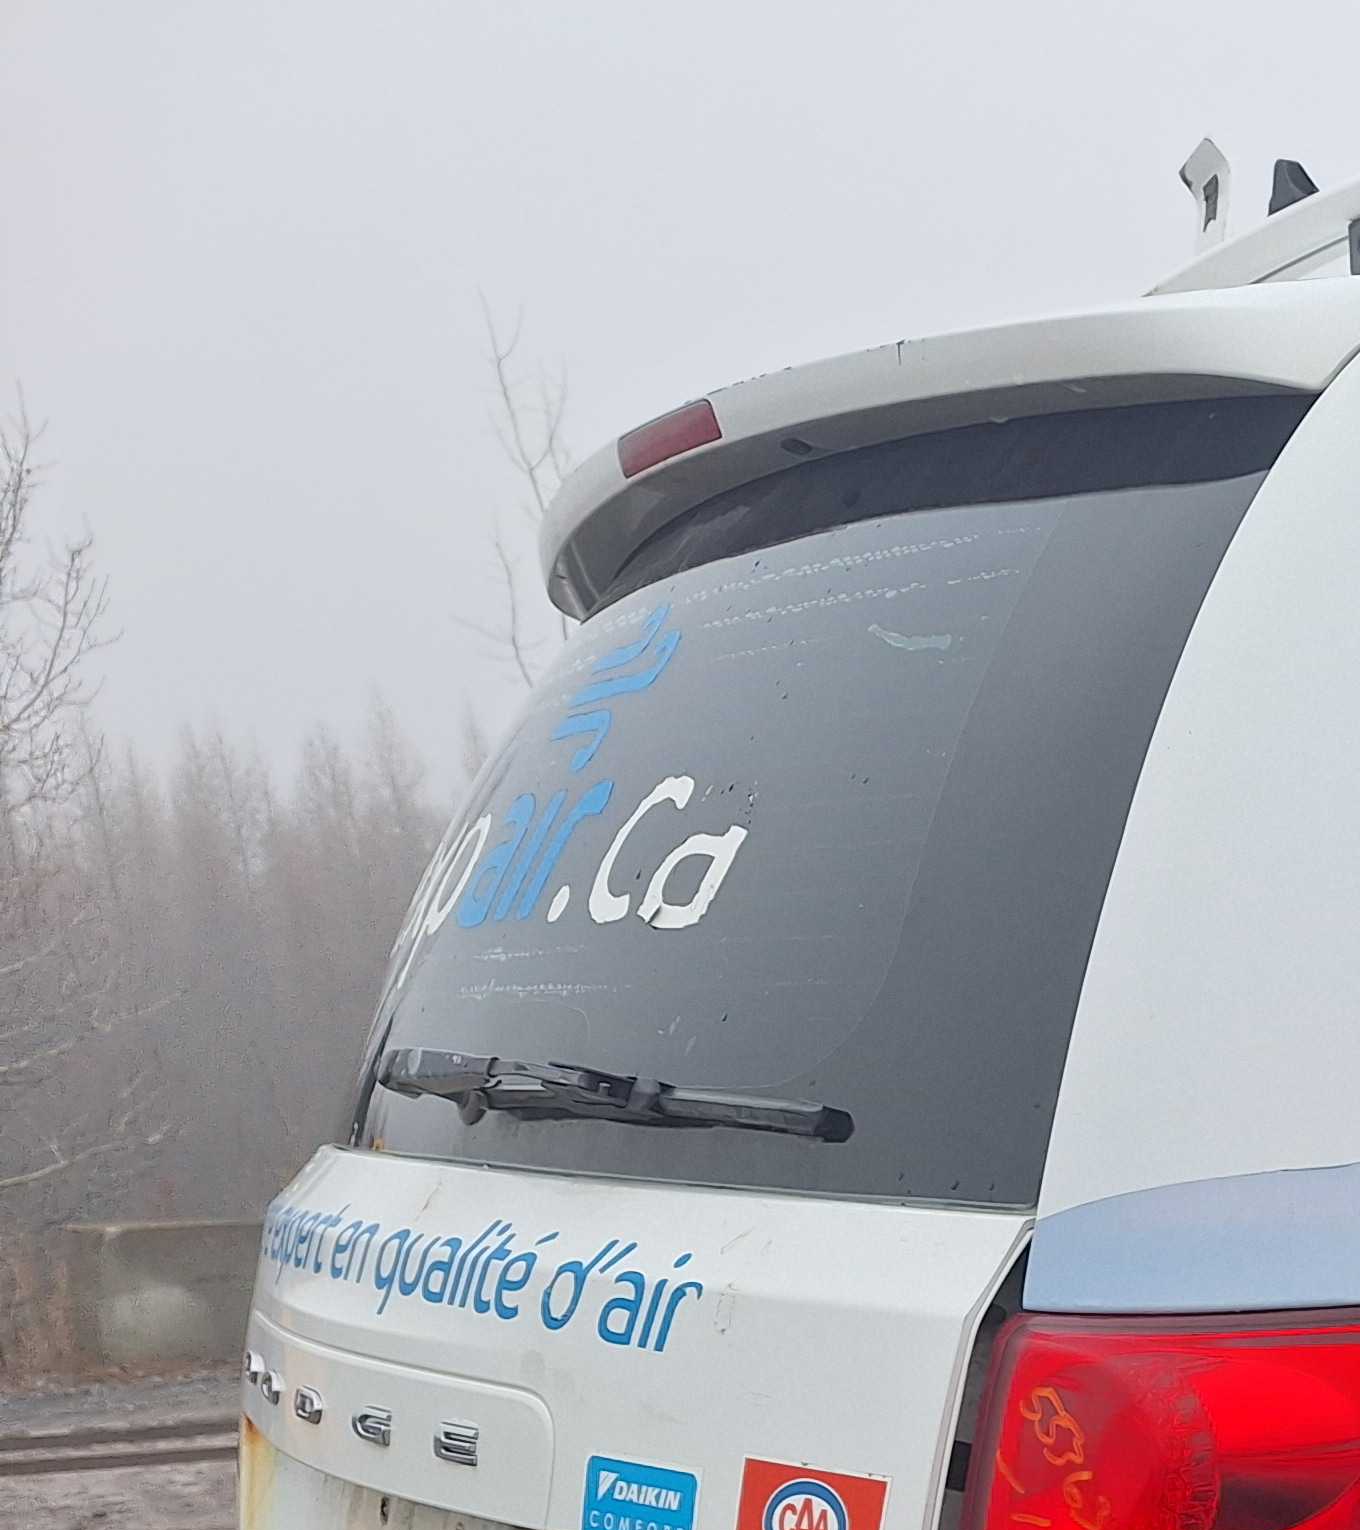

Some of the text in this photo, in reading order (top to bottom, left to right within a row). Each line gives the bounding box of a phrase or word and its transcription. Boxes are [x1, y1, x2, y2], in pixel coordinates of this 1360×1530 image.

[331, 1220, 380, 1284] en
[373, 1219, 560, 1321] qualité
[540, 1239, 704, 1352] d'air
[612, 1480, 682, 1511] DAIKIN
